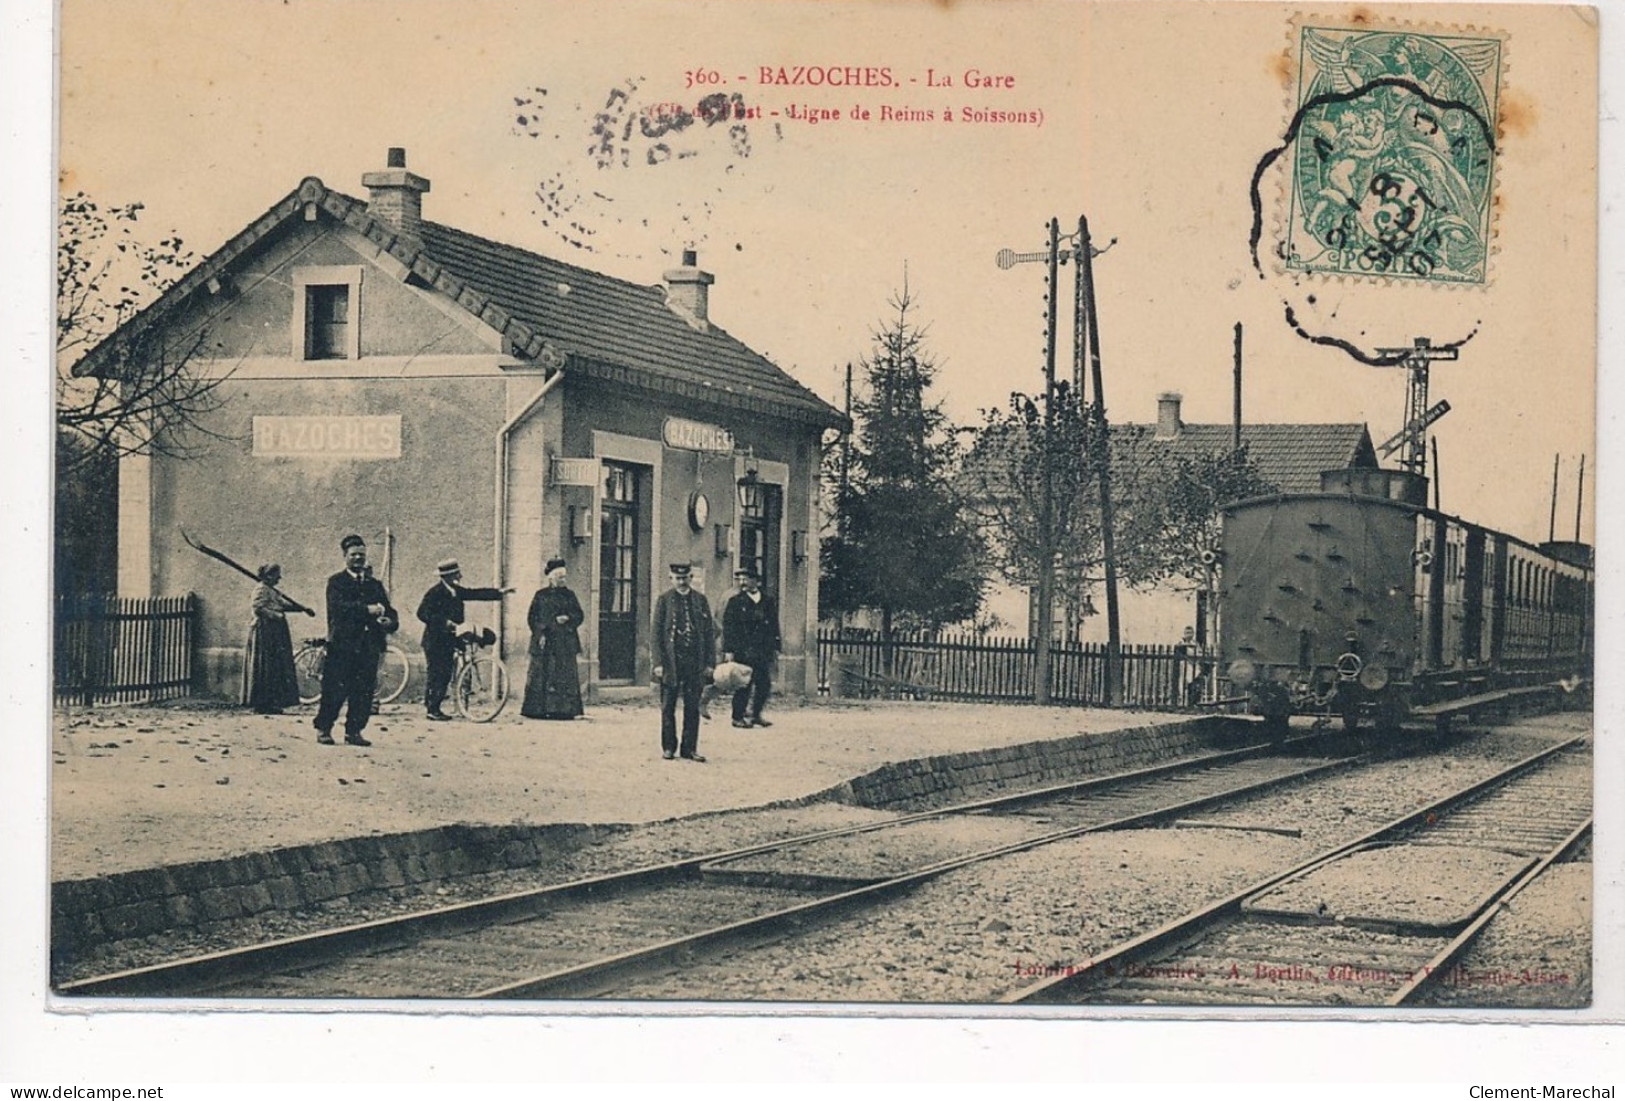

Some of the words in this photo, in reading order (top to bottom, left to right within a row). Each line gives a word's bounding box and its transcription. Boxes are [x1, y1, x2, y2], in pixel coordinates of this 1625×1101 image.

[260, 422, 394, 450] BAZOCHES
[667, 420, 730, 451] BAZOCHES
[556, 462, 597, 481] SORTI
